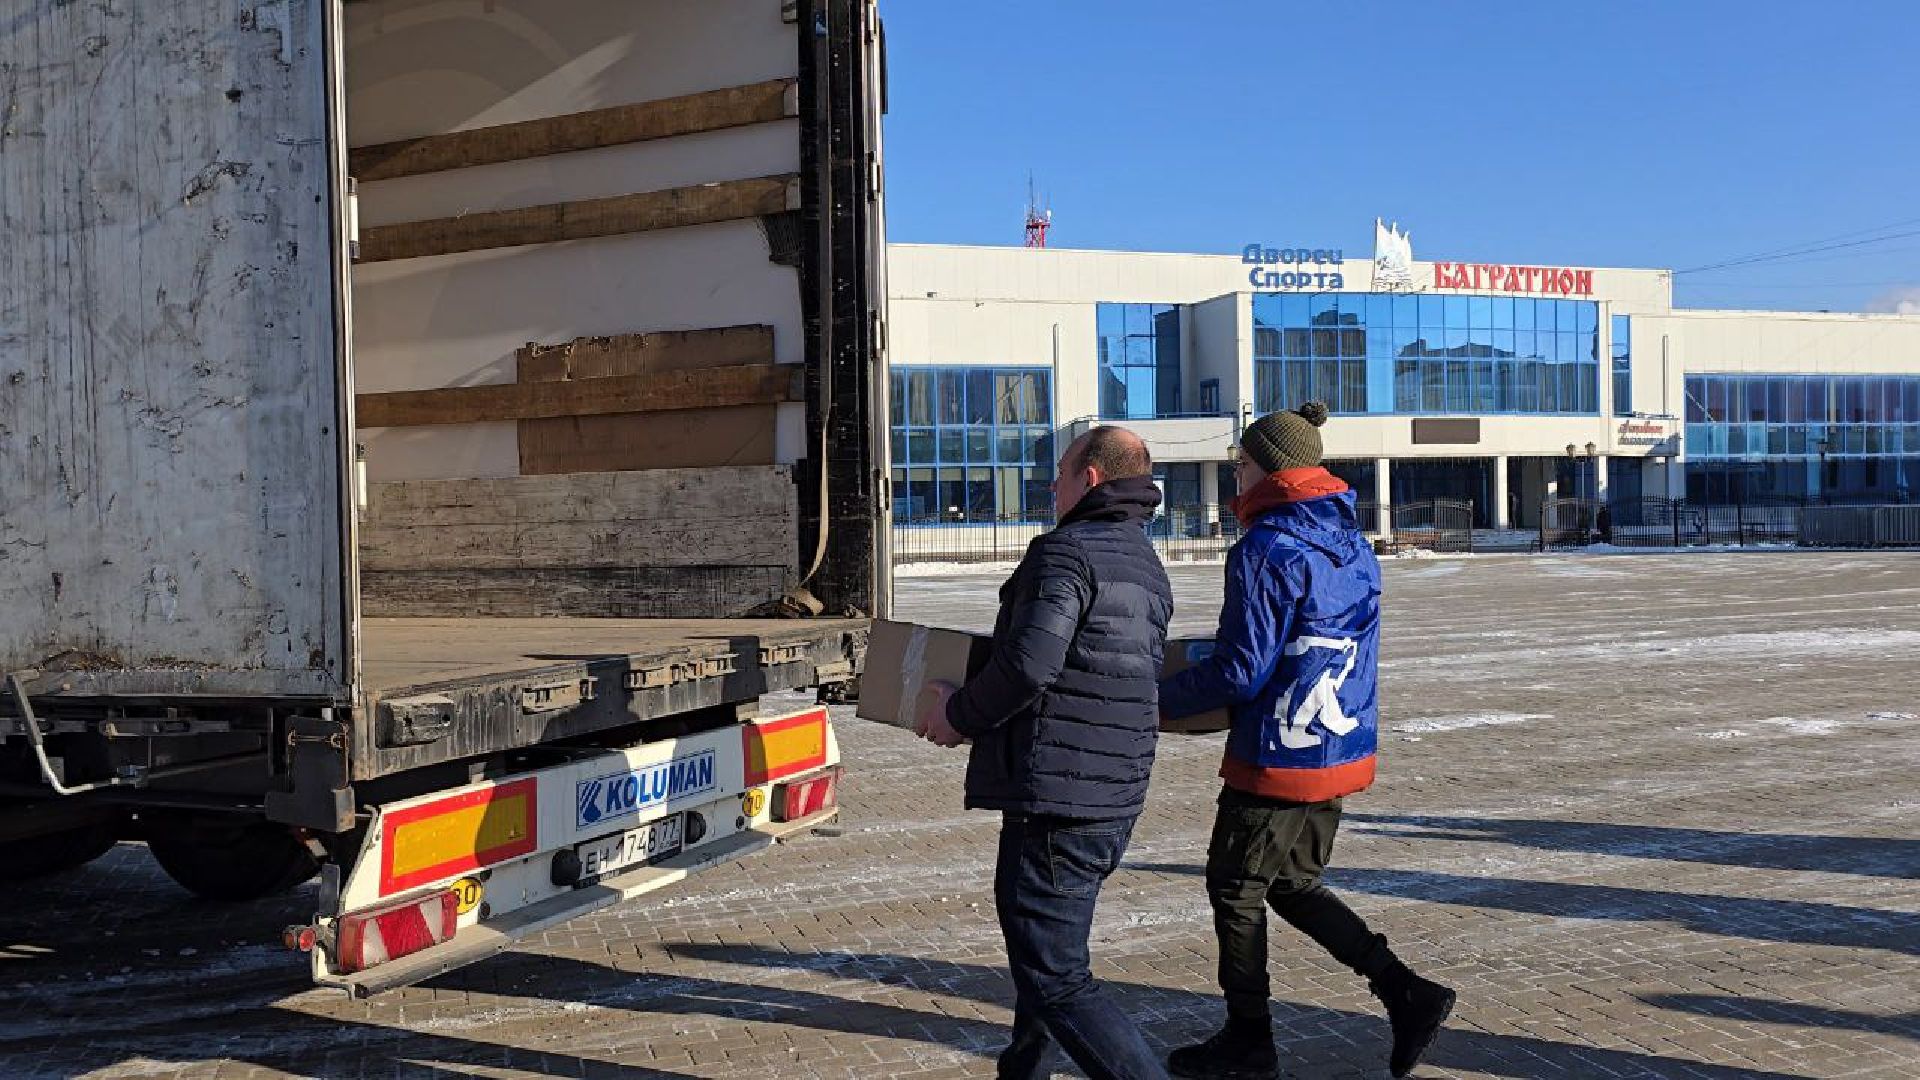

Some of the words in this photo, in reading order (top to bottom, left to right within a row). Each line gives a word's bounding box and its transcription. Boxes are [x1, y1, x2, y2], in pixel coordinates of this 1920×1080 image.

[1242, 244, 1344, 264] Дворец
[1249, 267, 1344, 288] Спорта
[1434, 263, 1593, 295] БАГРАТИОН
[606, 755, 713, 814] KOLUMAN
